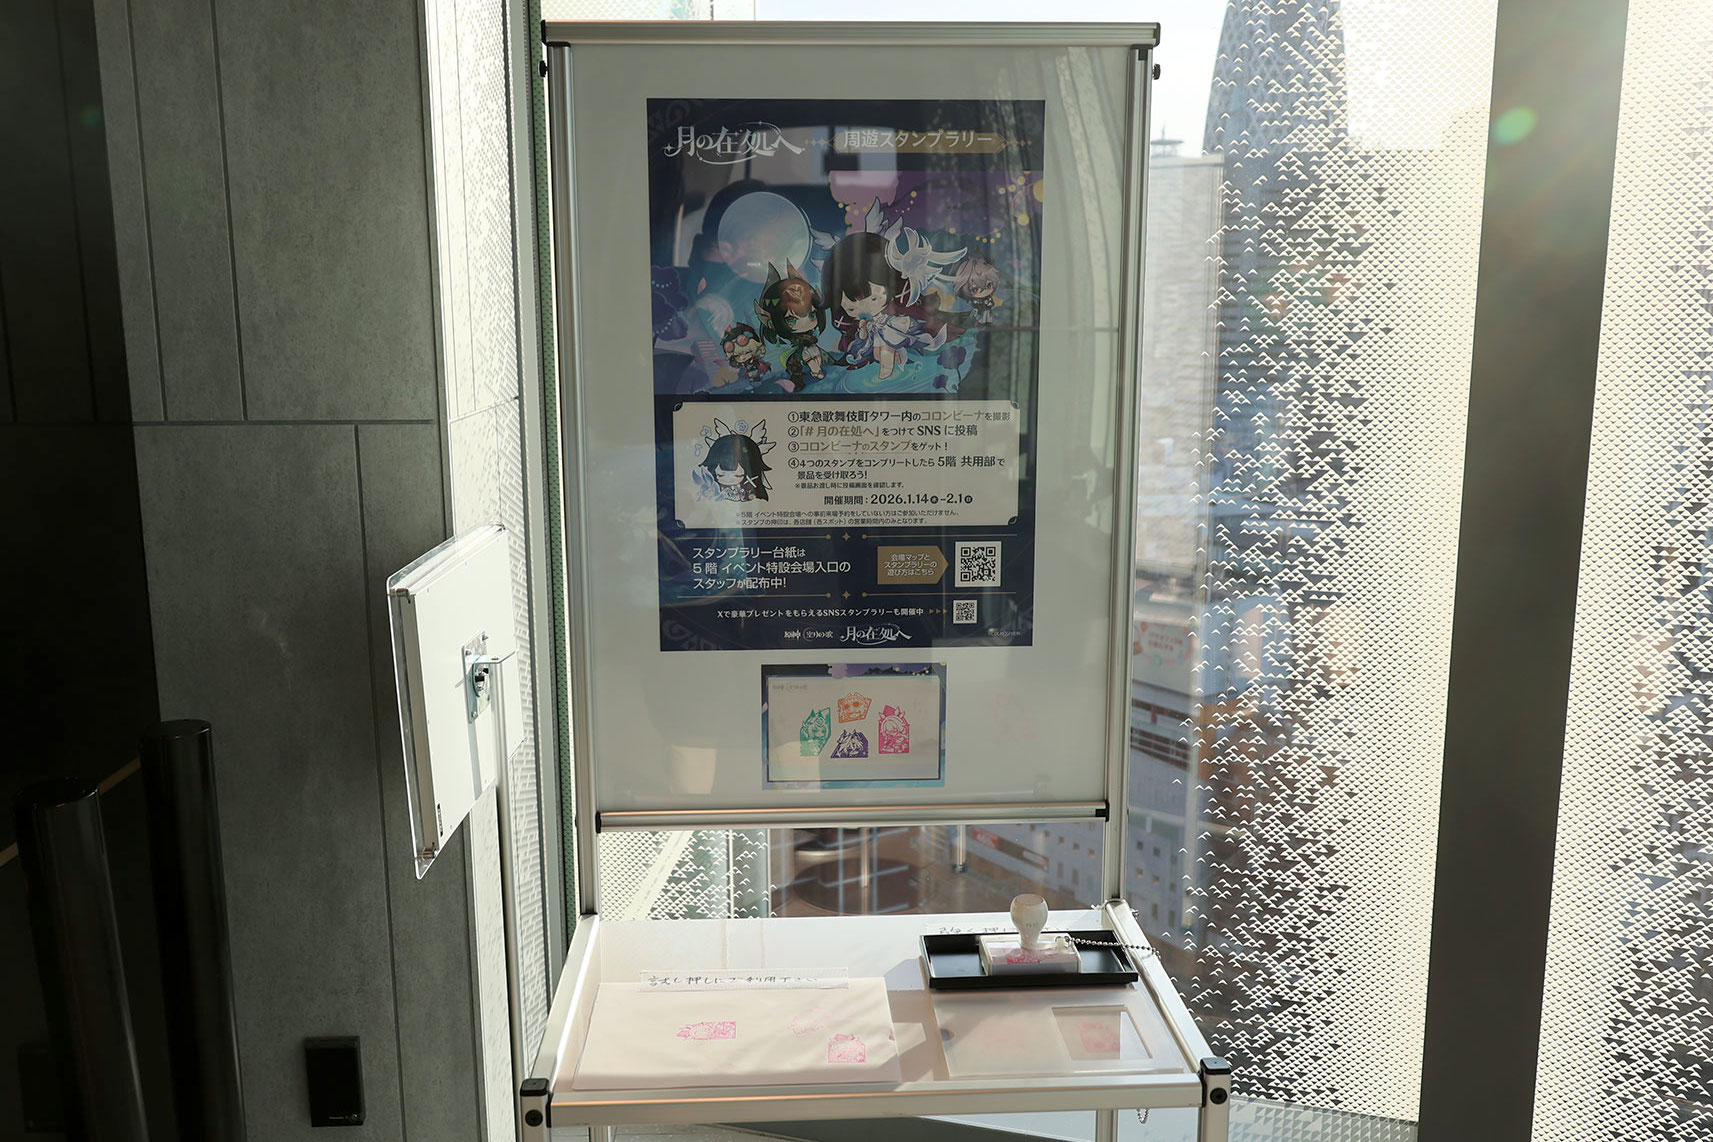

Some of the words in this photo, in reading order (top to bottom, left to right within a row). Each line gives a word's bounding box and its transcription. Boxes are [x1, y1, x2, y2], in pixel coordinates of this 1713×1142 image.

[664, 122, 805, 164] 月の在処へ
[843, 128, 993, 148] 周遊スタンプラリー
[692, 546, 806, 559] スタンプラリー台紙は
[891, 553, 930, 561] 会場マップと
[884, 561, 938, 569] スタンプラリーの
[840, 623, 913, 645] 月の在処へ
